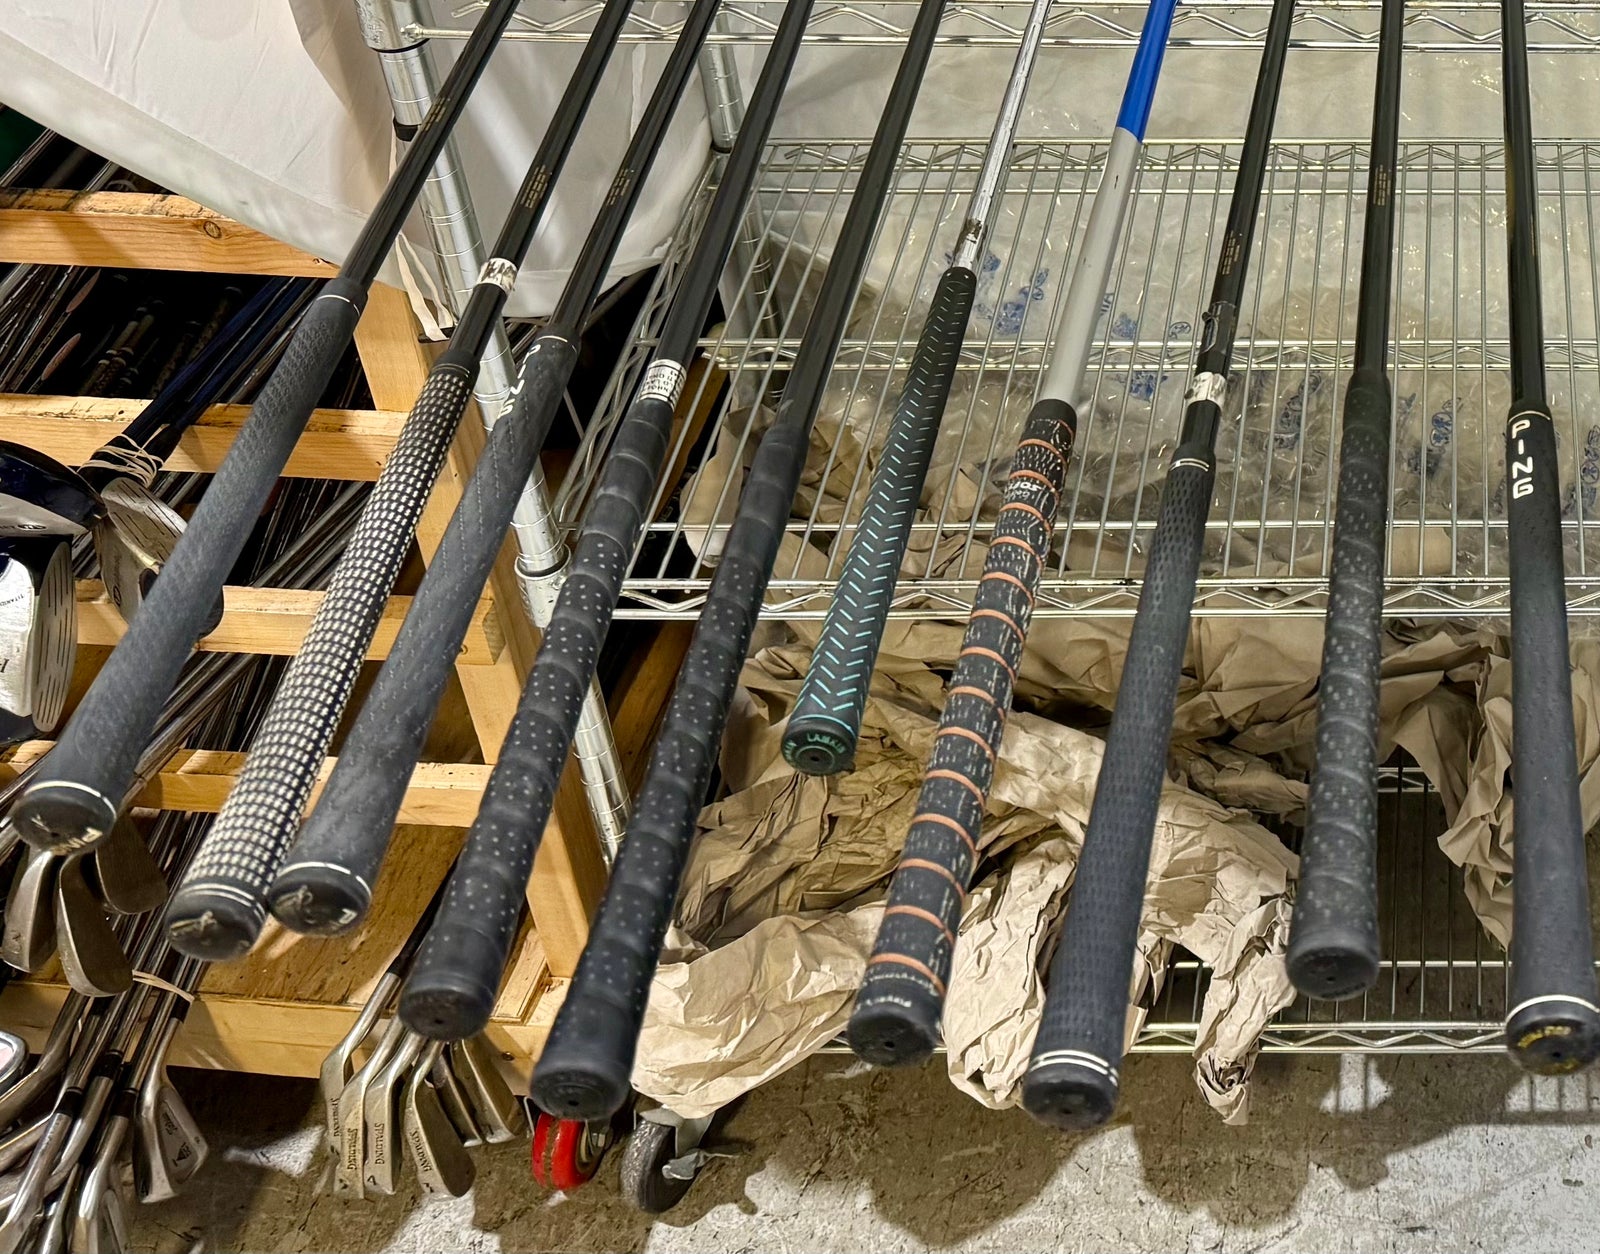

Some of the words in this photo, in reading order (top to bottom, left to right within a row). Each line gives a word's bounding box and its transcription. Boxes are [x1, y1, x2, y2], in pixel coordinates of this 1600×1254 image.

[1511, 419, 1534, 499] PING
[374, 1122, 386, 1165] SPALDING
[409, 1130, 433, 1173] SPALDING
